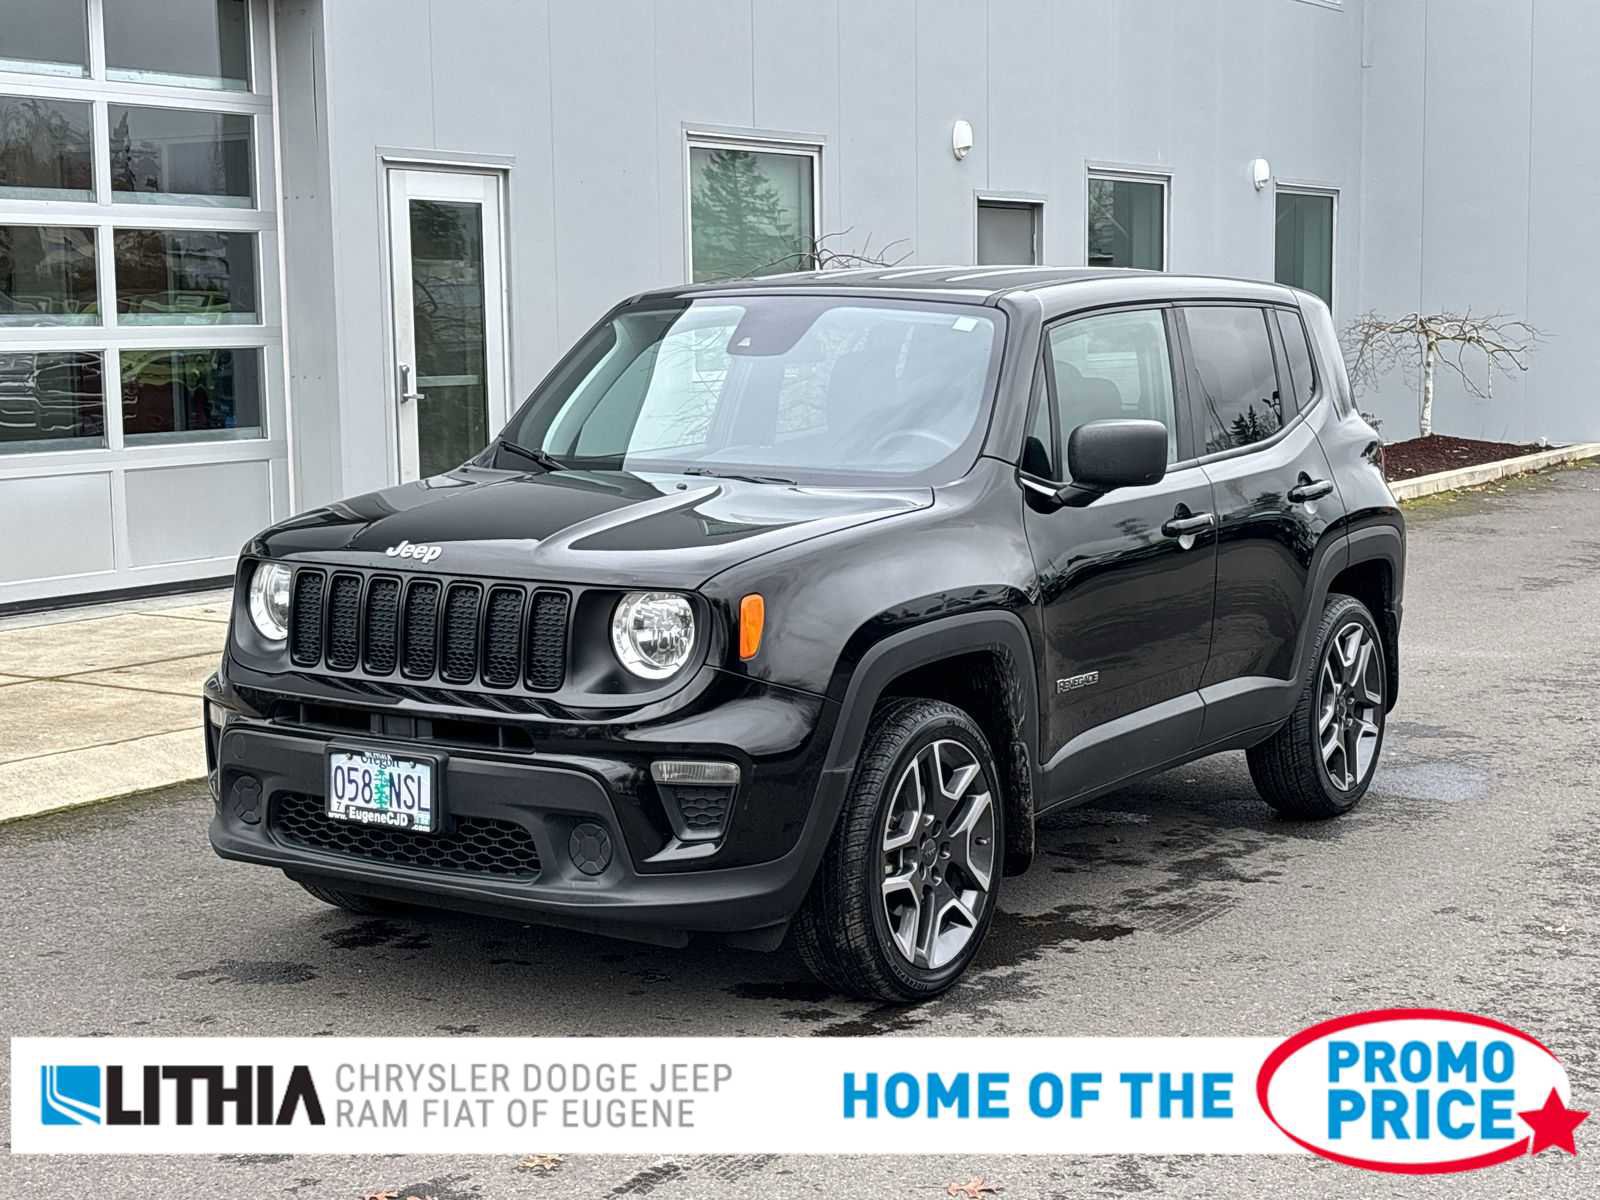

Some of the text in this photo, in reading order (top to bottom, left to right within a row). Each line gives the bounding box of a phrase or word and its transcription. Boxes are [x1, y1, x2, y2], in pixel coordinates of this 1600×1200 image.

[385, 540, 442, 563] Jeep
[334, 765, 430, 811] 058 NSL
[349, 806, 409, 826] EugeneCJD
